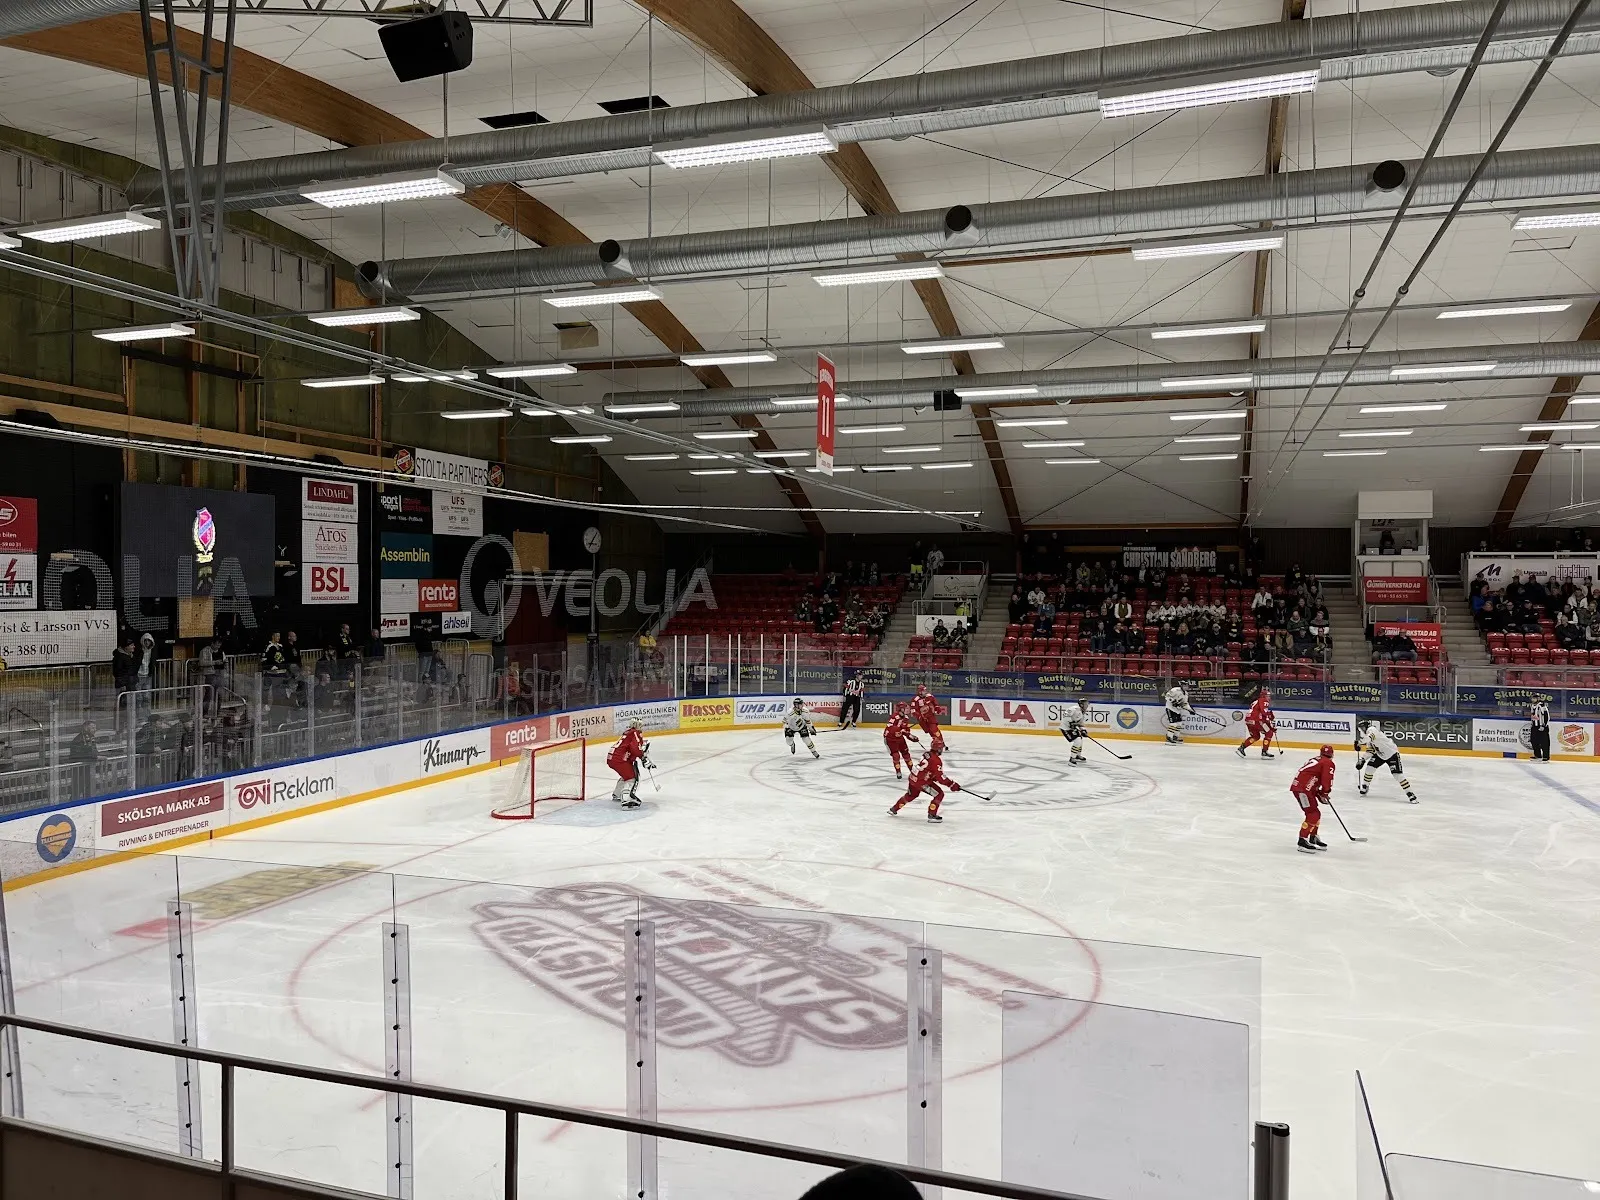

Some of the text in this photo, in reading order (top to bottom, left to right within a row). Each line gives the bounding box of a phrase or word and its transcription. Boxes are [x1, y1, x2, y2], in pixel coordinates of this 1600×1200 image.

[415, 457, 488, 486] STOLTA PARTNERS
[313, 487, 349, 499] LINDAHL
[451, 496, 465, 505] UFS
[315, 525, 347, 543] Aros
[380, 546, 431, 562] Assemblin
[1123, 551, 1217, 568] CHRISTIAN SANDBERG
[311, 566, 350, 593] BSL
[421, 583, 457, 602] renta
[532, 567, 719, 618] VEOLIA
[20, 621, 31, 633] &
[34, 620, 81, 632] Larsson
[83, 619, 111, 631] VVS
[16, 644, 37, 656] 388
[40, 643, 60, 655] 000
[965, 675, 1025, 688] skuttunge.se
[1038, 675, 1086, 687] Skuttunge
[1098, 678, 1158, 693] skuttunge.s
[1329, 683, 1382, 696] Skuttunge
[1493, 689, 1554, 702] Skuttuge
[615, 705, 678, 719] HÖGANÄSKLINIKEN
[682, 704, 731, 718] Hasses
[739, 703, 785, 714] UMB AB
[866, 702, 889, 713] sport
[959, 699, 991, 722] LA
[1003, 701, 1036, 723] LA
[571, 715, 607, 729] SVENSKA
[1297, 721, 1350, 731] HANDELSSTÅL
[1384, 720, 1468, 734] SNICKERI
[505, 724, 537, 746] renta
[572, 727, 590, 738] SPEL
[1385, 731, 1468, 743] PORTALEN
[423, 739, 486, 772] Kinnarps
[273, 774, 335, 804] Reklam
[117, 795, 211, 824] SKÖLSTA MARK AB
[118, 835, 147, 848] RIVNING
[154, 820, 210, 839] ENTREPRENADER
